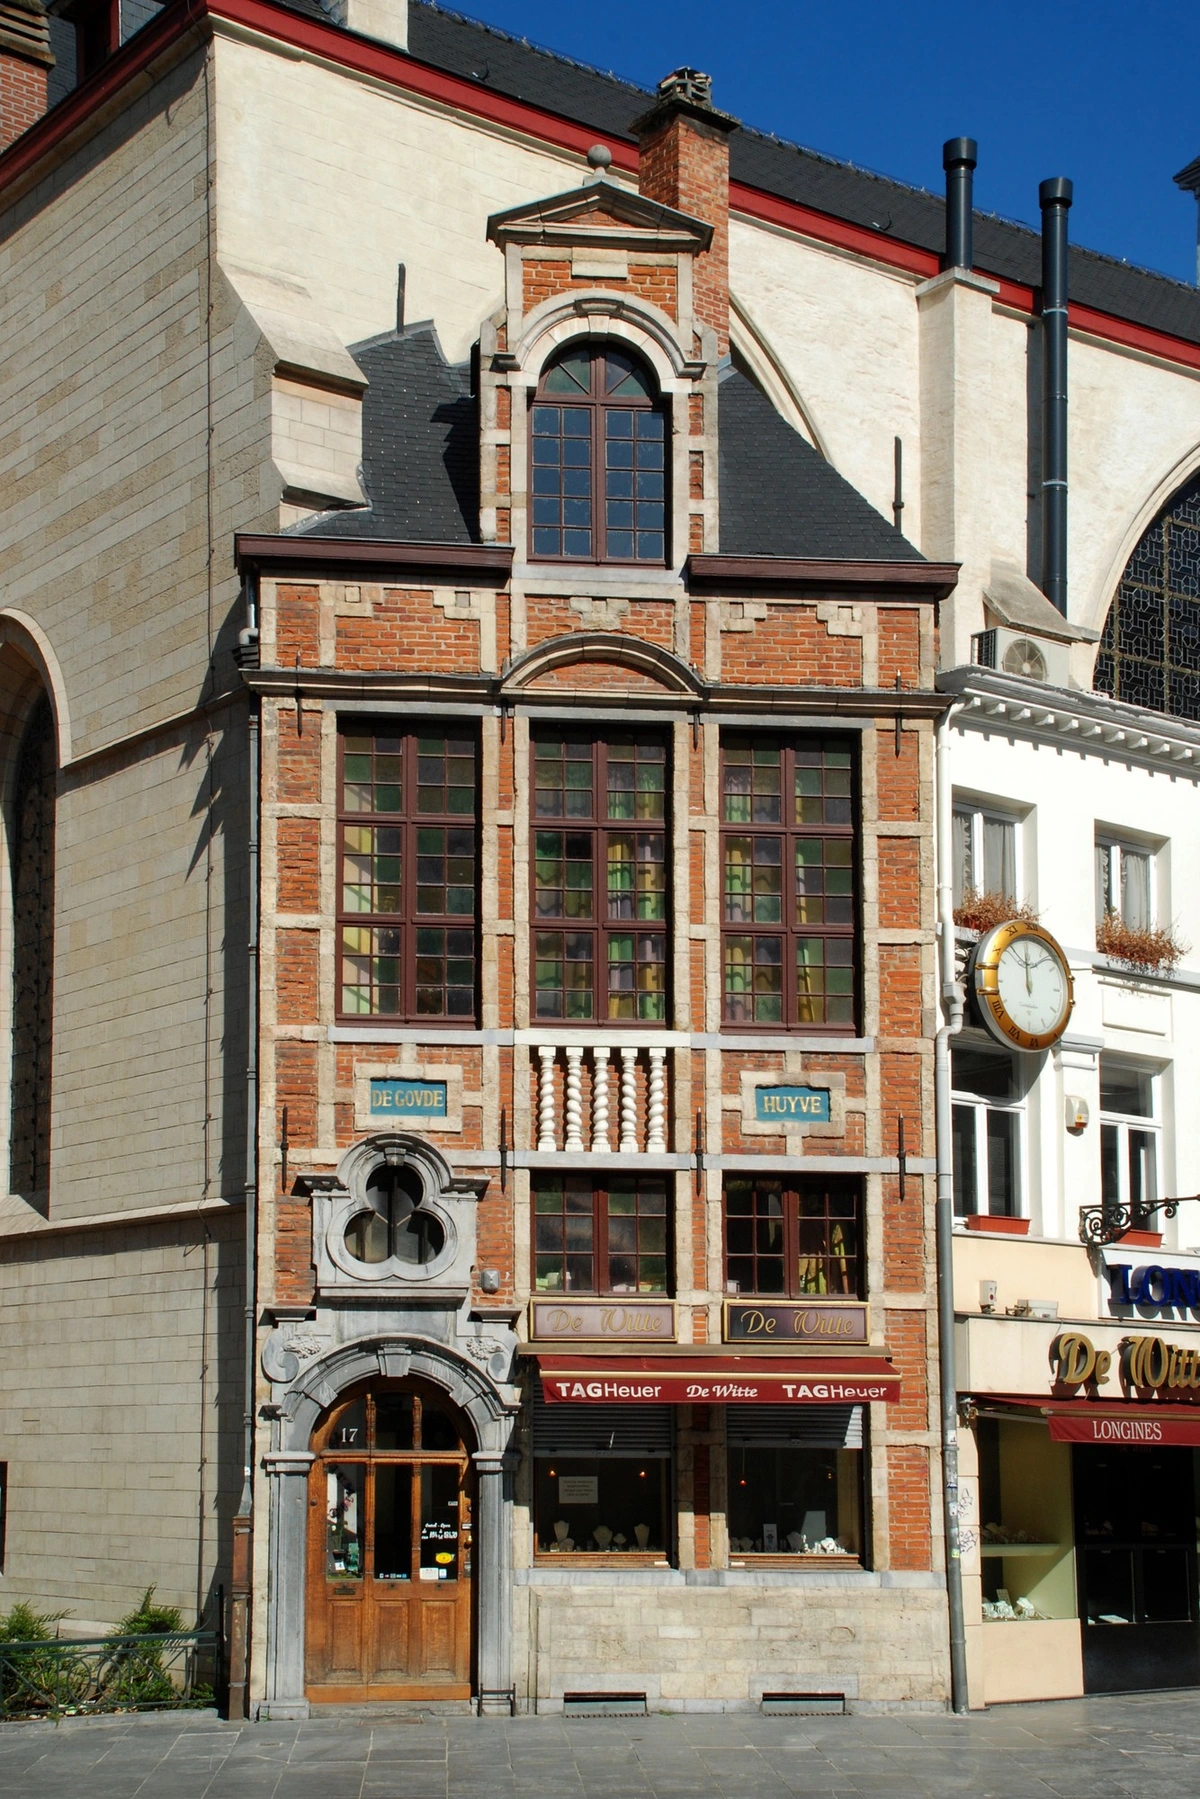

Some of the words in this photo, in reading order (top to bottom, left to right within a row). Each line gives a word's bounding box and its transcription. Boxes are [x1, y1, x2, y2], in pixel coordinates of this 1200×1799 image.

[371, 1090, 392, 1107] DE
[394, 1090, 444, 1107] GOVDE
[763, 1095, 821, 1113] HUYVE
[1107, 1264, 1200, 1309] LON
[546, 1308, 584, 1332] De
[600, 1308, 663, 1333] Witte
[740, 1310, 777, 1333] De
[793, 1310, 854, 1335] Witte
[1058, 1332, 1112, 1385] De
[686, 1384, 709, 1398] De
[712, 1383, 758, 1398] Witte
[341, 1427, 358, 1443] 17
[1092, 1420, 1163, 1441] LONGINES
